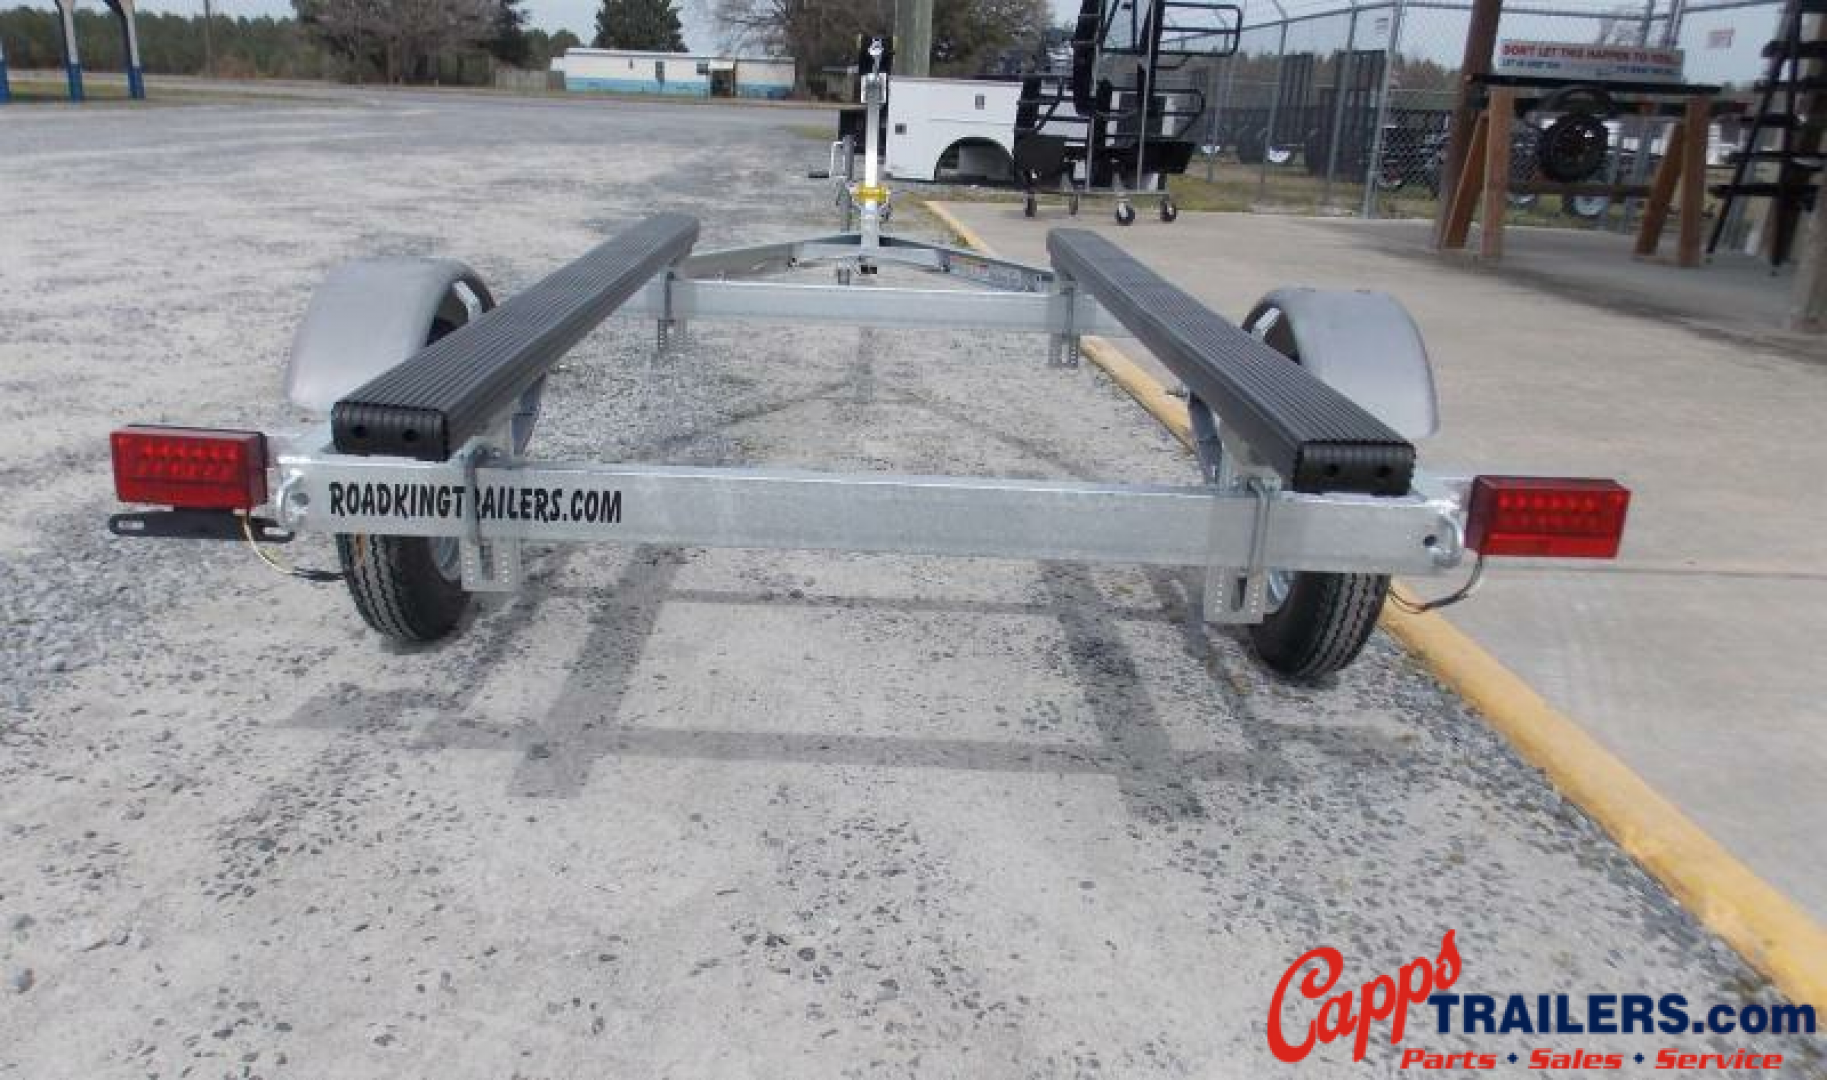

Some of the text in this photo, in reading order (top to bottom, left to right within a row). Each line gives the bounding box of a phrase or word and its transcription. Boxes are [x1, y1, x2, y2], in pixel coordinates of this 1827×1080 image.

[1502, 45, 1536, 56] DON'T
[1538, 46, 1557, 58] LET
[1559, 47, 1584, 59] THIS
[1586, 49, 1629, 61] HAPPEN
[1634, 52, 1648, 63] TO
